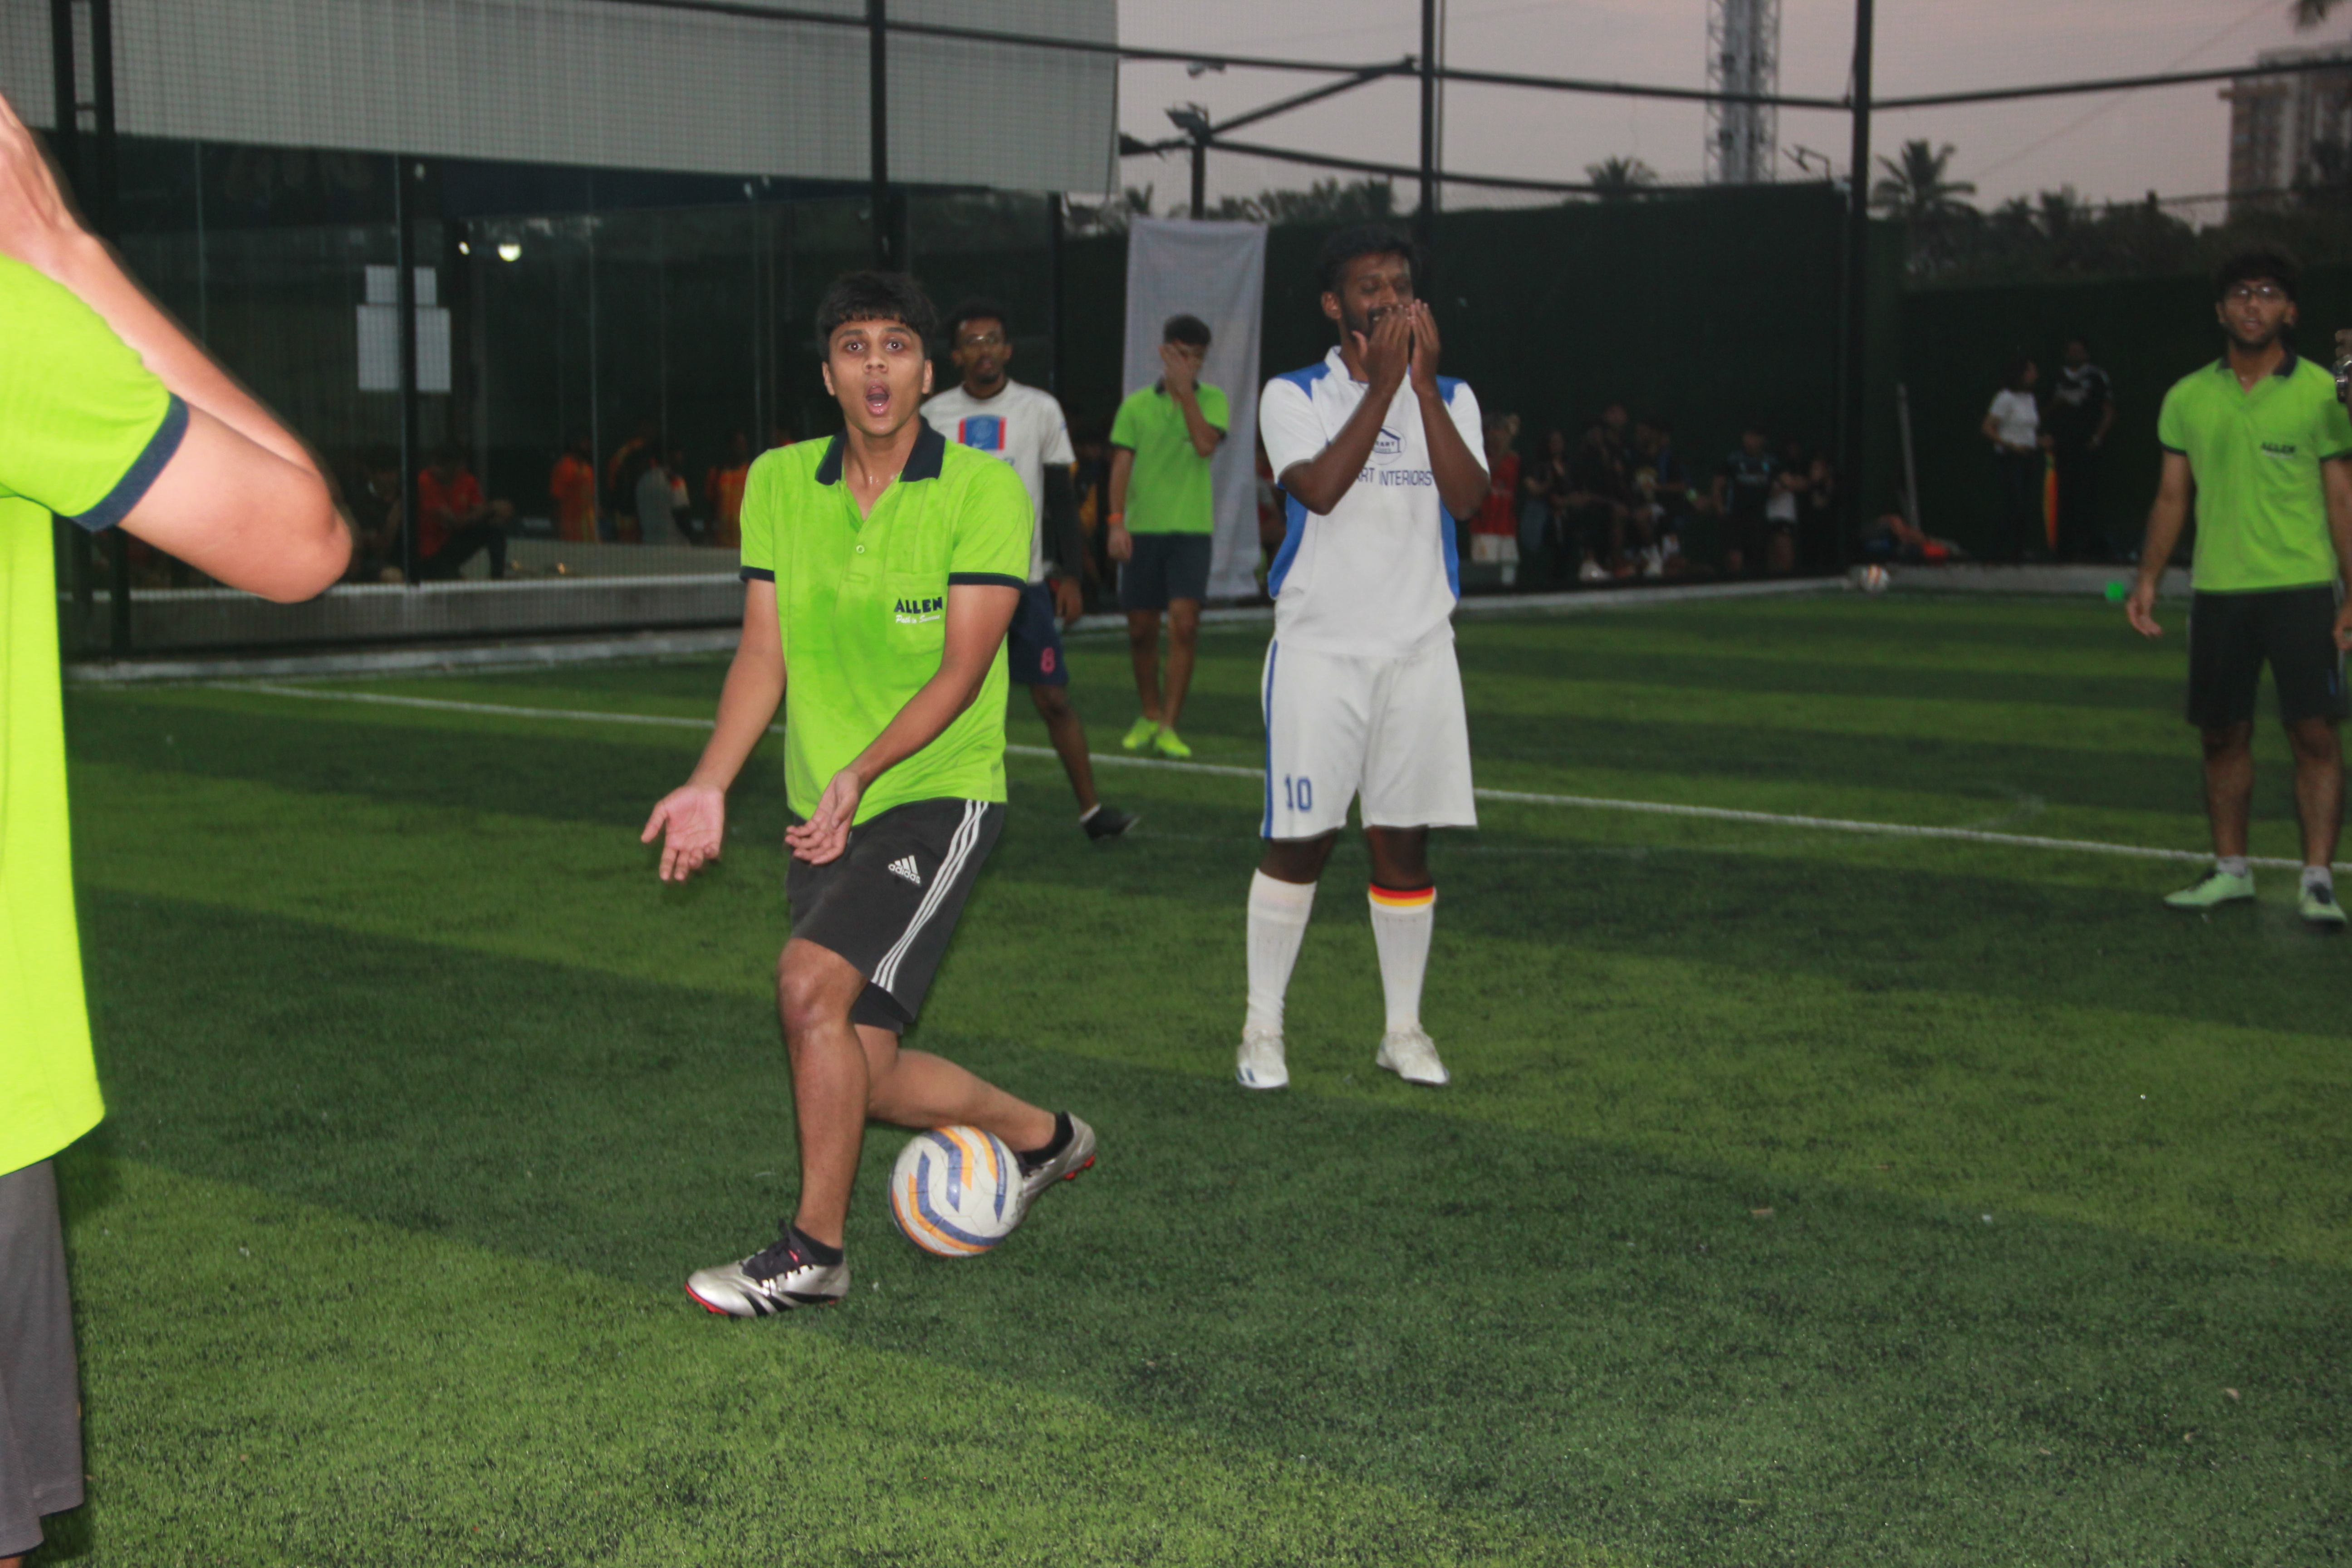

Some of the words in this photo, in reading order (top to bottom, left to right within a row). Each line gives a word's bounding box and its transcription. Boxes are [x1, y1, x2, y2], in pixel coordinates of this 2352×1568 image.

[1379, 470, 1432, 486] INTERIORS
[894, 597, 943, 614] ALLEN
[1285, 774, 1312, 812] 10
[888, 863, 921, 884] adidas
